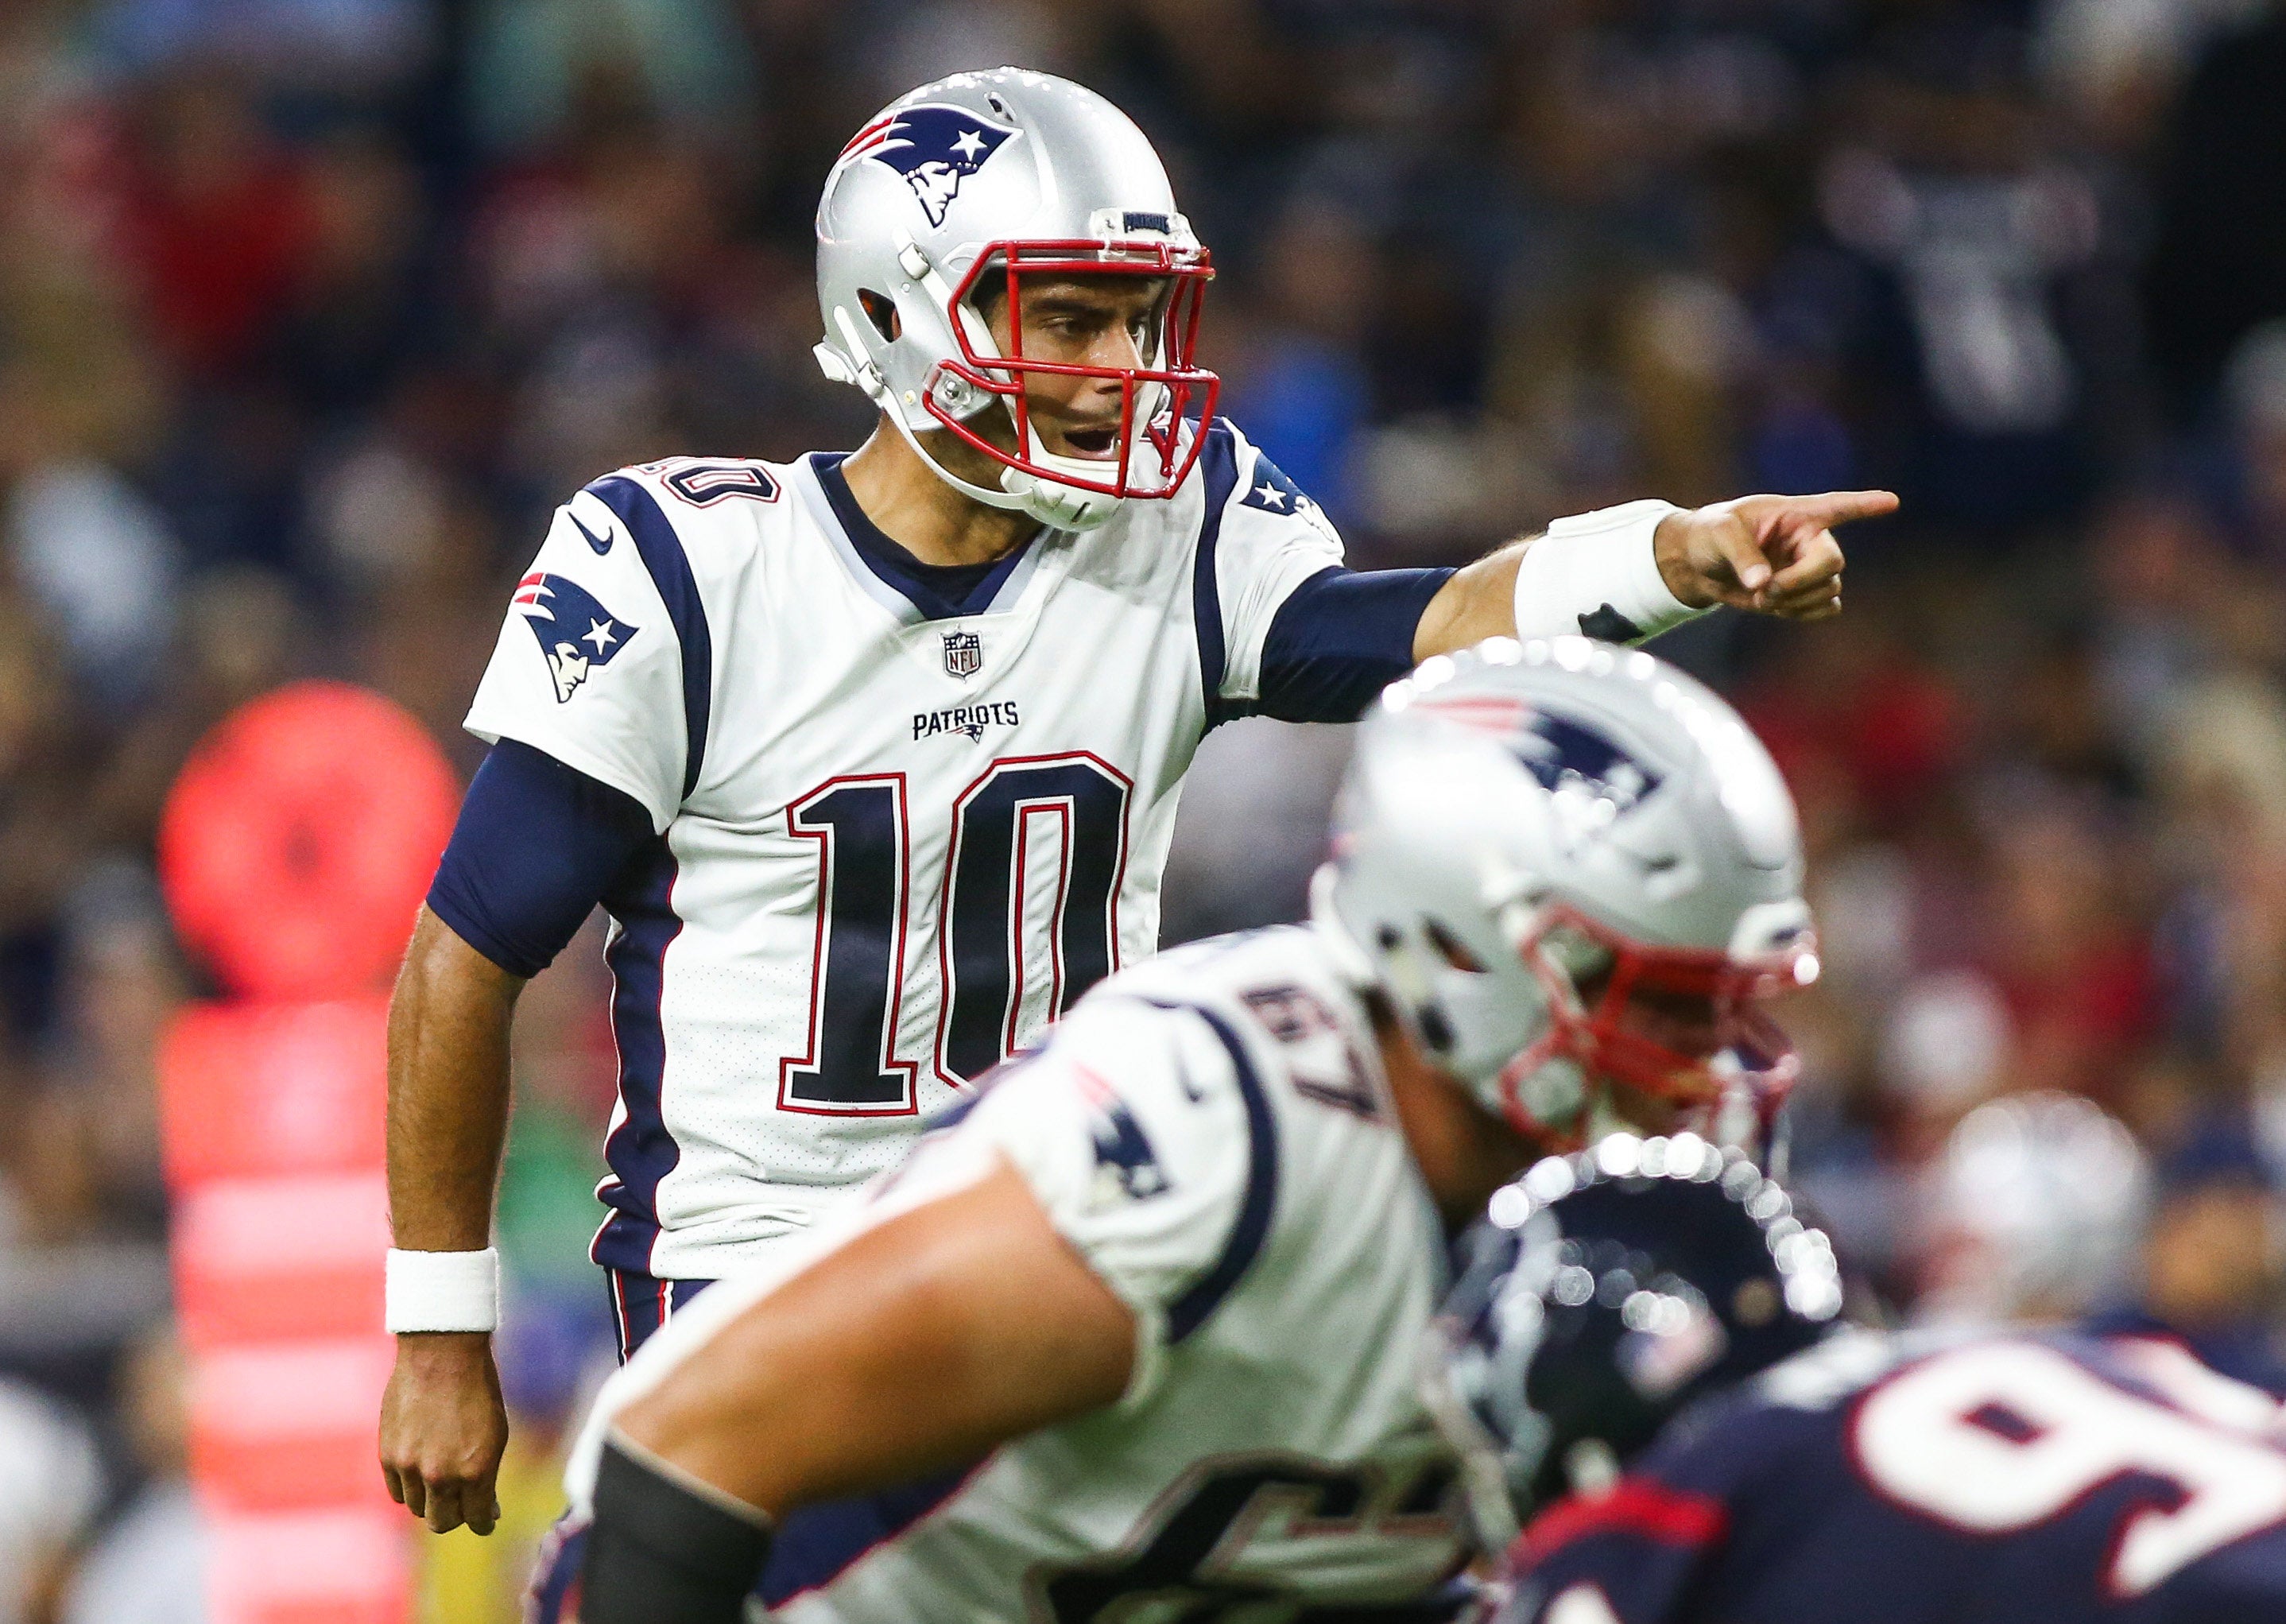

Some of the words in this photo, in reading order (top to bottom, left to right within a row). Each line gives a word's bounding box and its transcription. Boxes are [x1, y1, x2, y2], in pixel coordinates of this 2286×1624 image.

[948, 649, 978, 673] NFL
[912, 700, 1020, 741] PATRIOTS
[777, 750, 1134, 1117] 10
